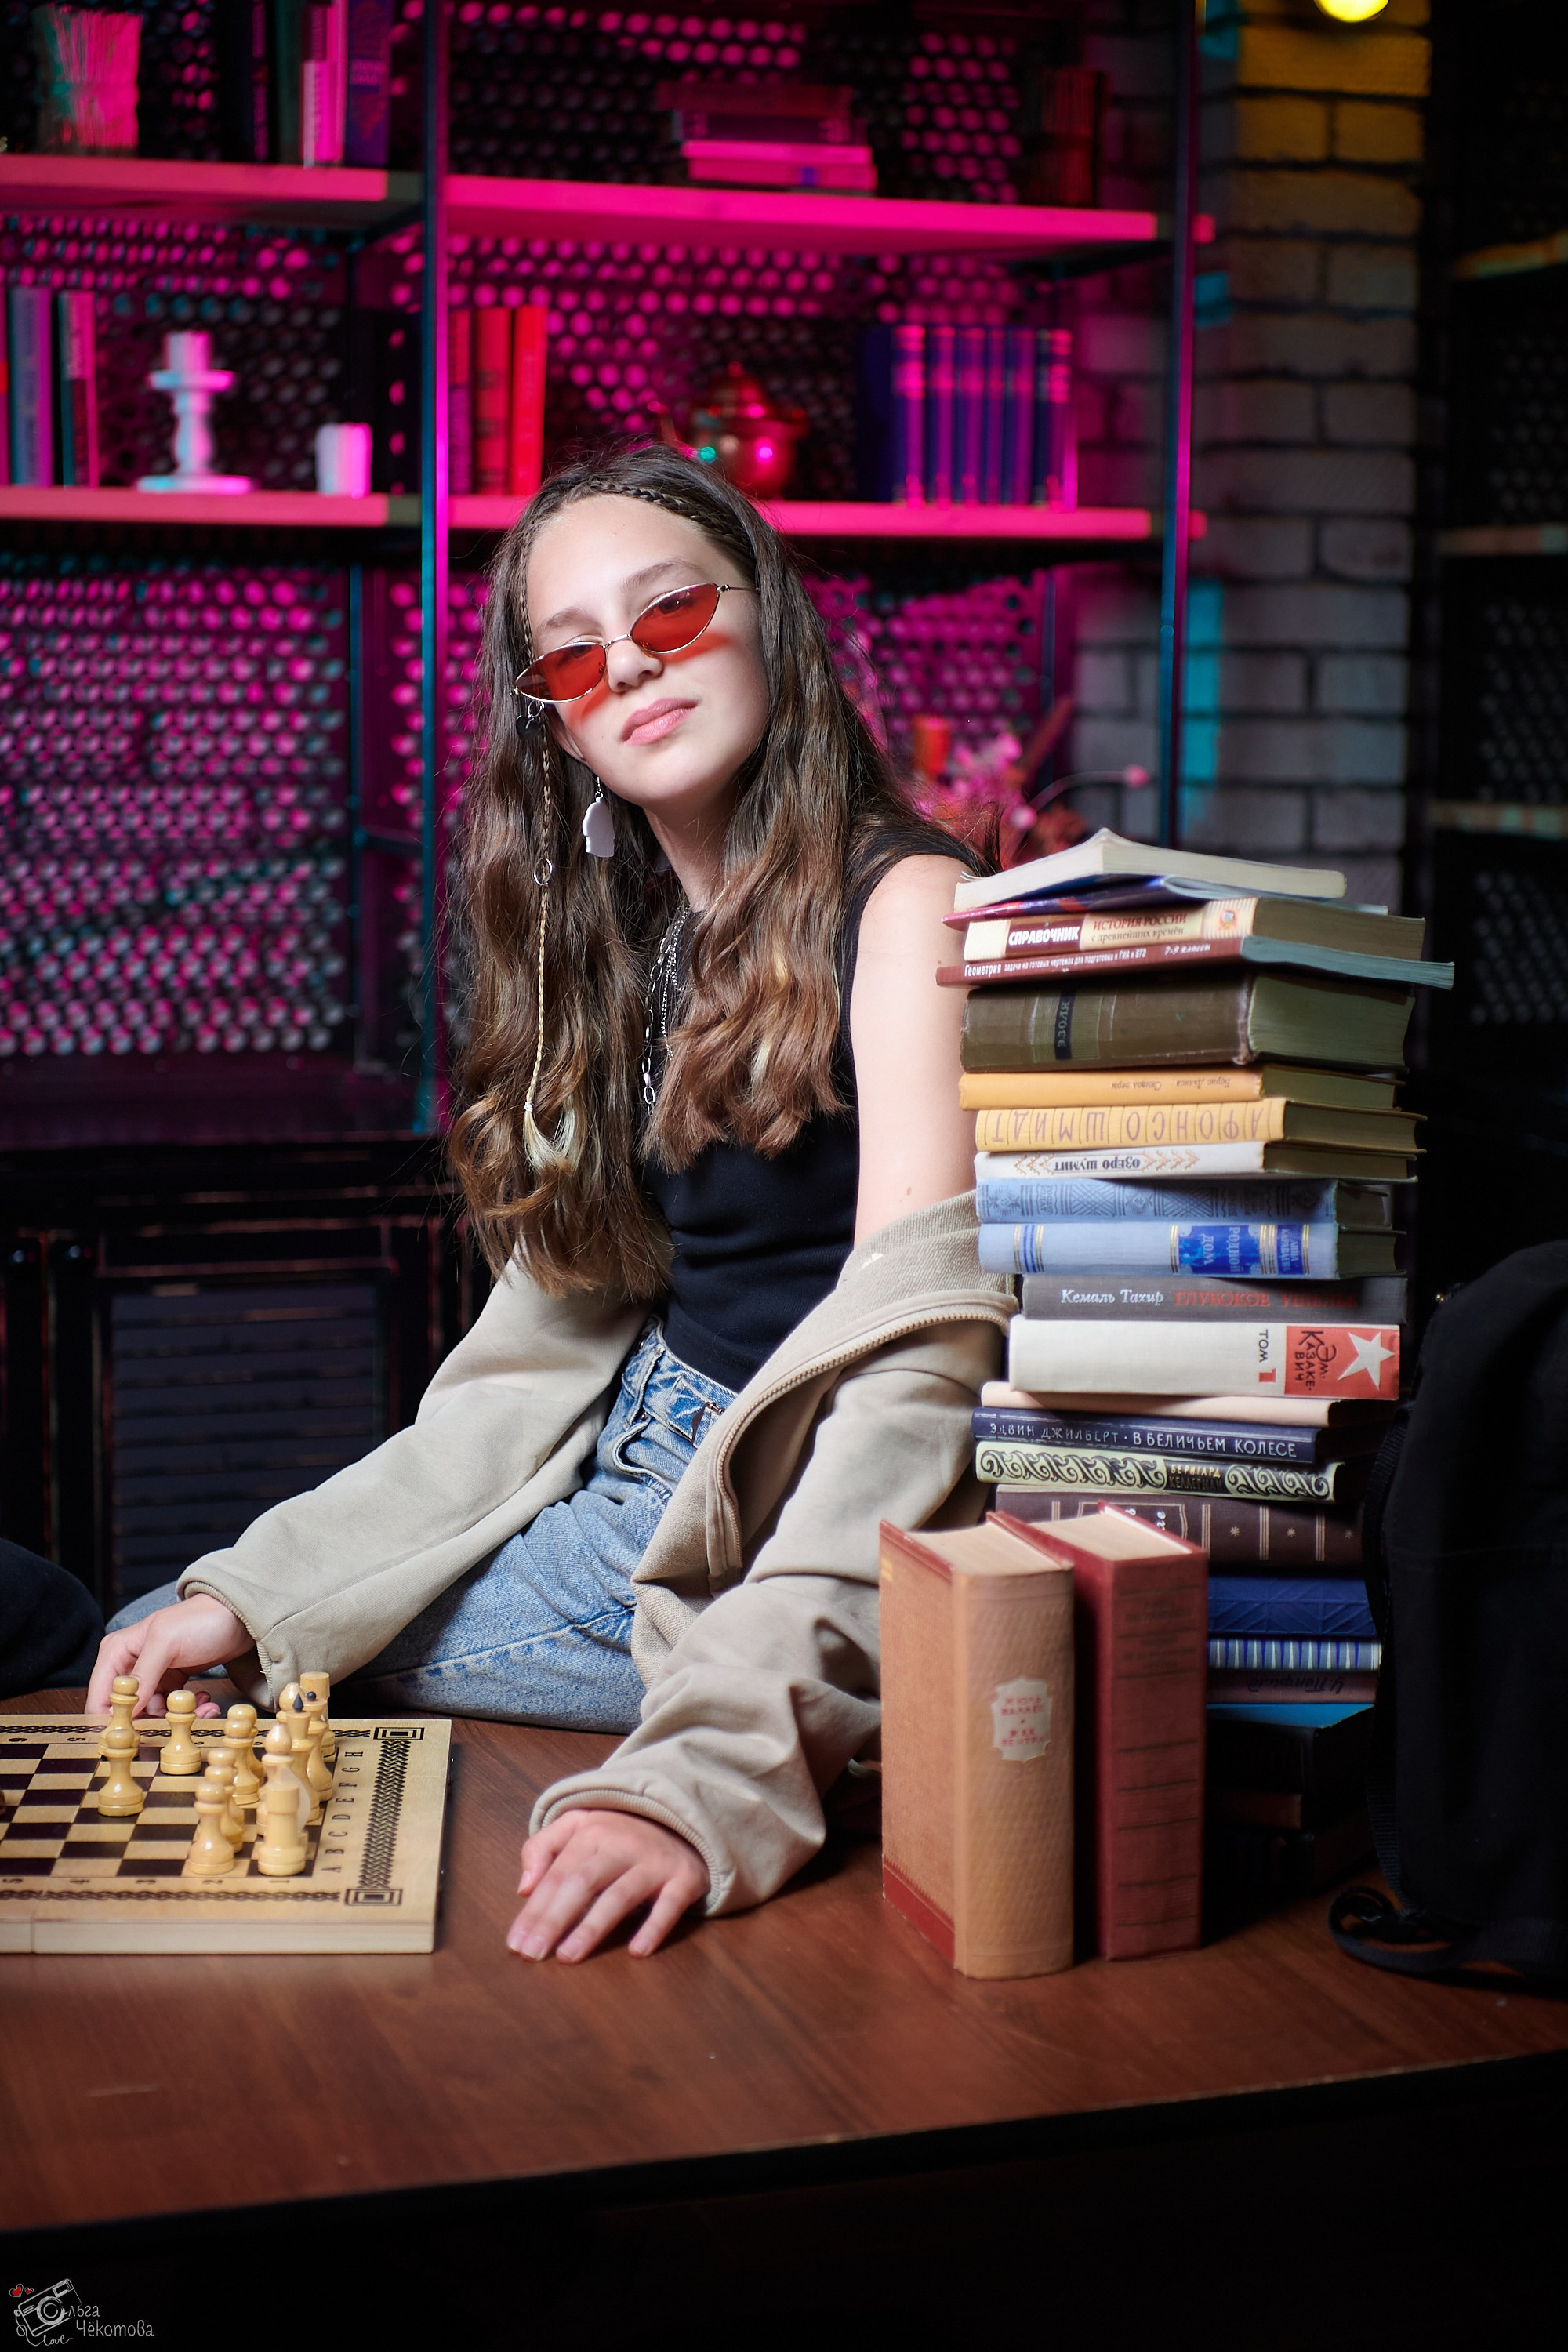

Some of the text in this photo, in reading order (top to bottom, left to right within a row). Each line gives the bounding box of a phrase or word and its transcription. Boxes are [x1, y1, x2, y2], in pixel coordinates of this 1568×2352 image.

[1093, 913, 1187, 931] ИСТОРИЯ РОССИИ
[1008, 926, 1080, 946] СПРАВОЧНИК
[1098, 929, 1150, 944] древнейших
[964, 963, 1001, 978] Геометрия
[1004, 961, 1021, 973] задачи
[1022, 961, 1029, 970] на
[1029, 959, 1049, 970] готовых
[1051, 956, 1073, 969] чертежах
[1074, 956, 1084, 965] для
[1085, 953, 1113, 964] подготовки
[1119, 949, 1131, 960] ГИА
[1135, 948, 1148, 958] ЕГЭ
[992, 1108, 1264, 1142] АФОНСО ШМИДТ
[1054, 1156, 1141, 1171] ОЗЕРО ШУМИТ
[1200, 1233, 1214, 1265] ДОМ
[1229, 1227, 1242, 1273] РОДНОЙ
[1061, 1289, 1115, 1305] Кемаль
[1120, 1289, 1164, 1307] Тахир
[1175, 1290, 1270, 1307] ГЛУБОКОЕ
[1259, 1367, 1276, 1383] 1
[1295, 1352, 1305, 1381] ВИЧ
[990, 1423, 1298, 1458] ЭДВИН ДЖИЛБЕРТ В БЕЛИЧЬЕМ КОЛЕСЕ
